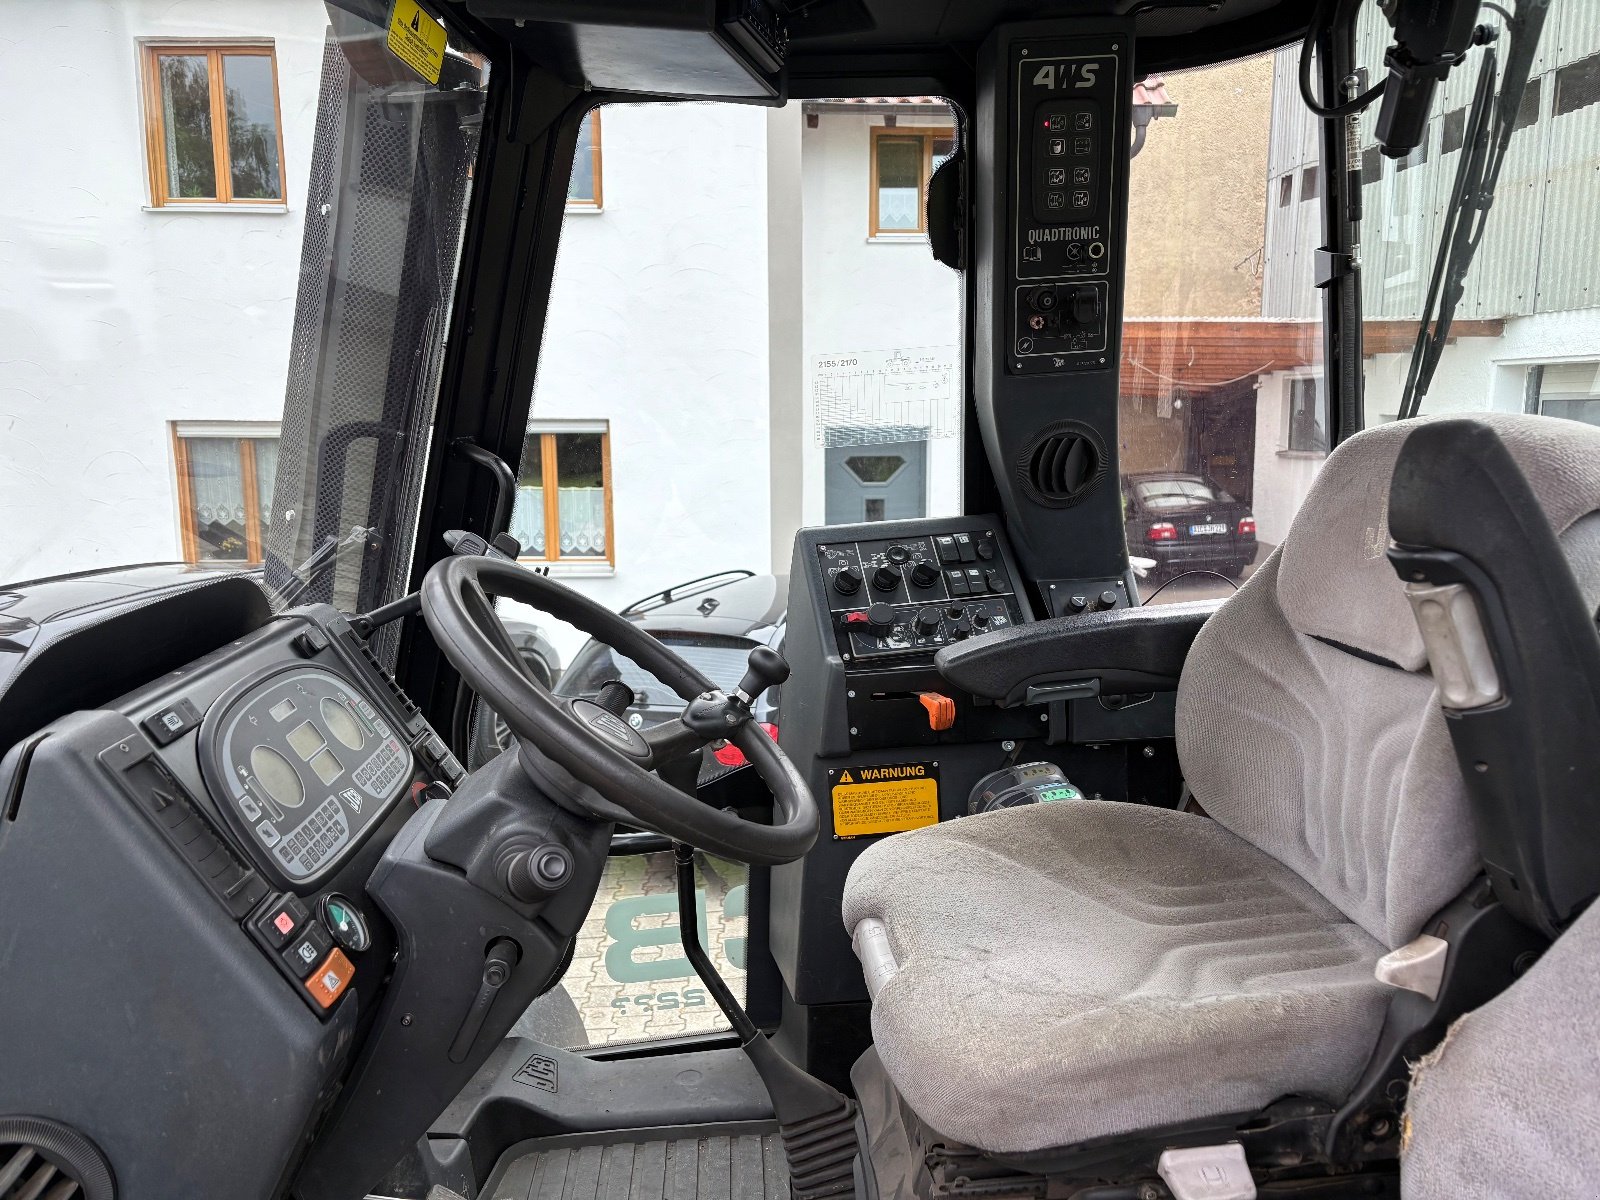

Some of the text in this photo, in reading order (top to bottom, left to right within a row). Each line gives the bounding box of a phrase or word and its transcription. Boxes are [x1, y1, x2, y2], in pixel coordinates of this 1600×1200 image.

[1028, 226, 1100, 243] QUADTRONIC
[818, 358, 858, 368] 2155/2170
[860, 765, 925, 780] WARNUNG
[518, 1057, 556, 1091] JCB
